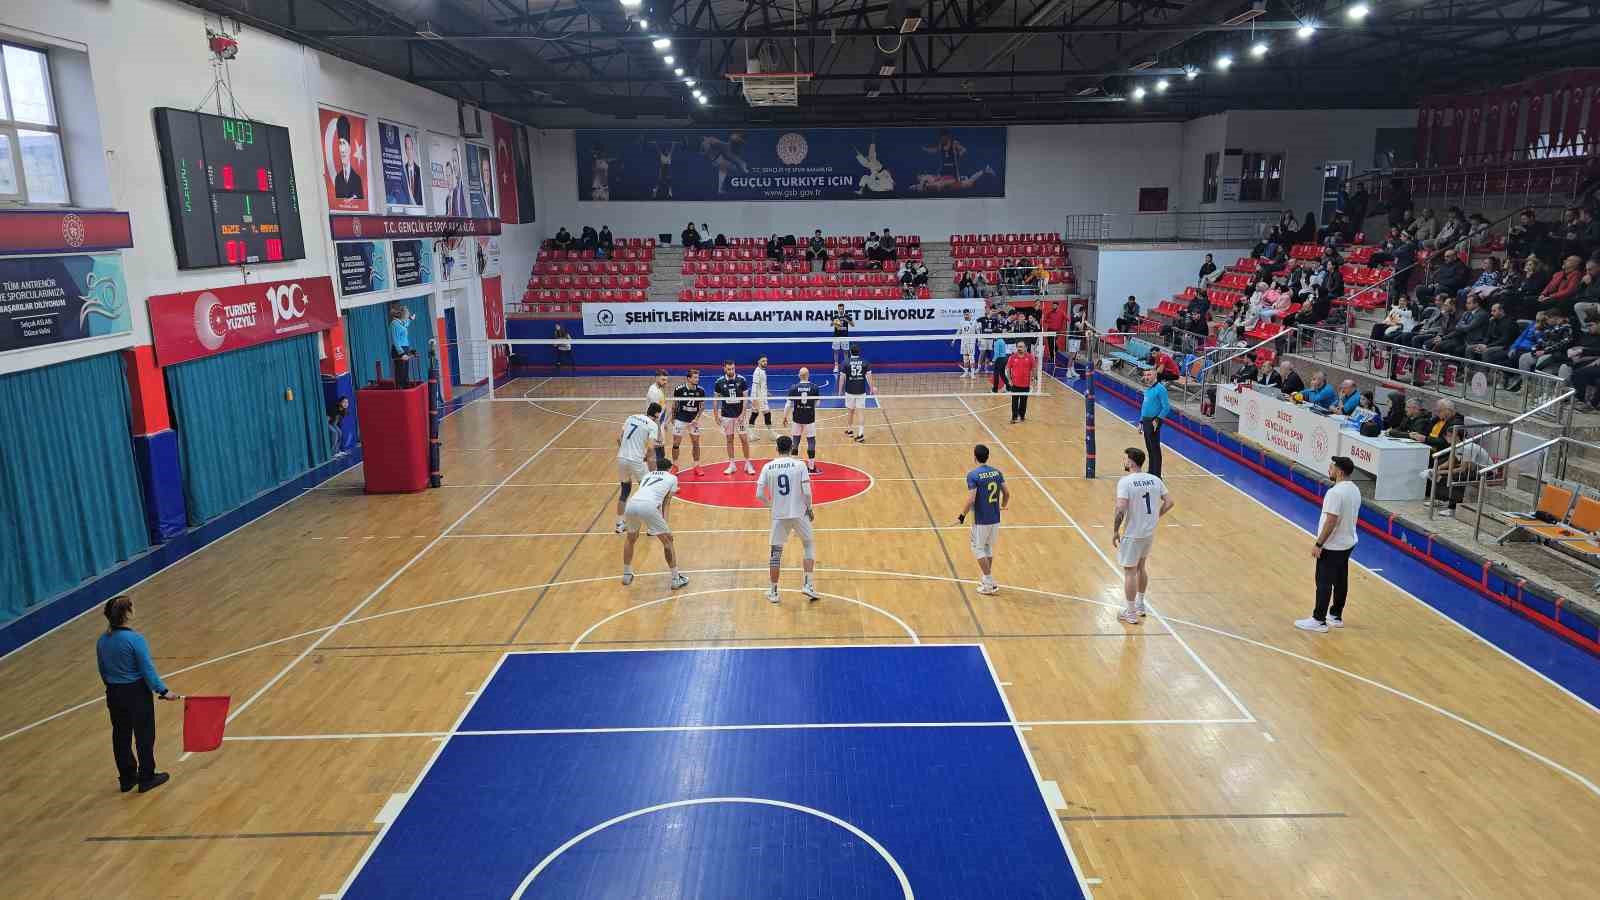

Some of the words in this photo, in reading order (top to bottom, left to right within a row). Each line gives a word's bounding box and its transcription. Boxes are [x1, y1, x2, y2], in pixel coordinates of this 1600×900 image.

[434, 221, 449, 234] SPO
[625, 308, 725, 325] ŞEHİTLERİMİZE
[728, 309, 802, 322] ALLAH'TAN
[864, 306, 936, 321] DİLİYORUZ
[851, 365, 863, 377] 52
[626, 423, 638, 440] 7
[777, 474, 790, 496] 9
[987, 481, 998, 503] 2
[1141, 491, 1152, 515] 1
